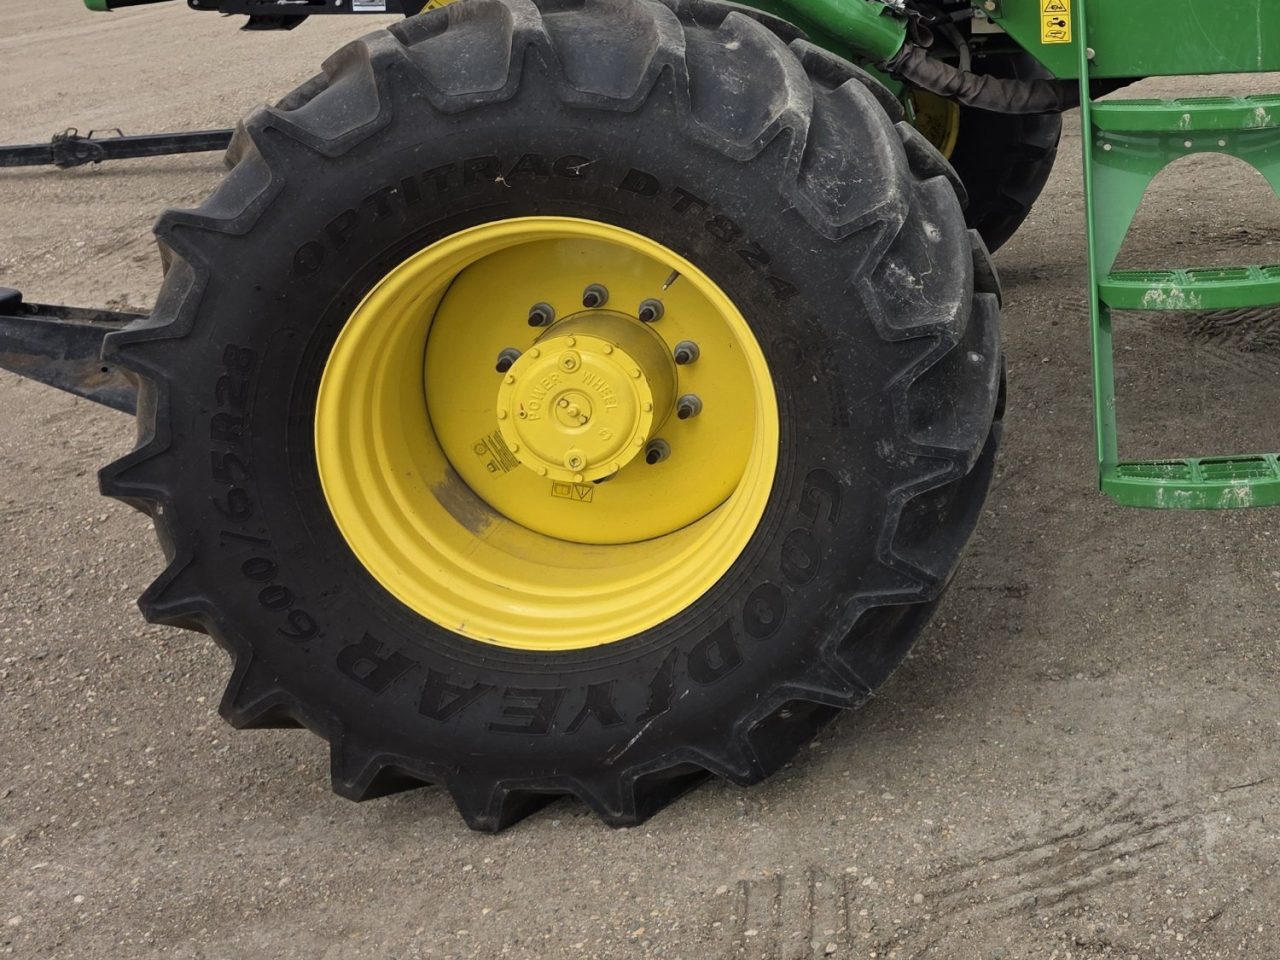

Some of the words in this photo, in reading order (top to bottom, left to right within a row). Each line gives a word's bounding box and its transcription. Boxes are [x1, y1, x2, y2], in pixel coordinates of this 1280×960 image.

[292, 152, 592, 276] OPTITRAC
[616, 167, 800, 302] DT824
[209, 342, 322, 641] 600/65R28
[528, 372, 563, 422] POWER
[582, 370, 618, 414] WHEEL
[335, 467, 843, 737] GOODYEAR
